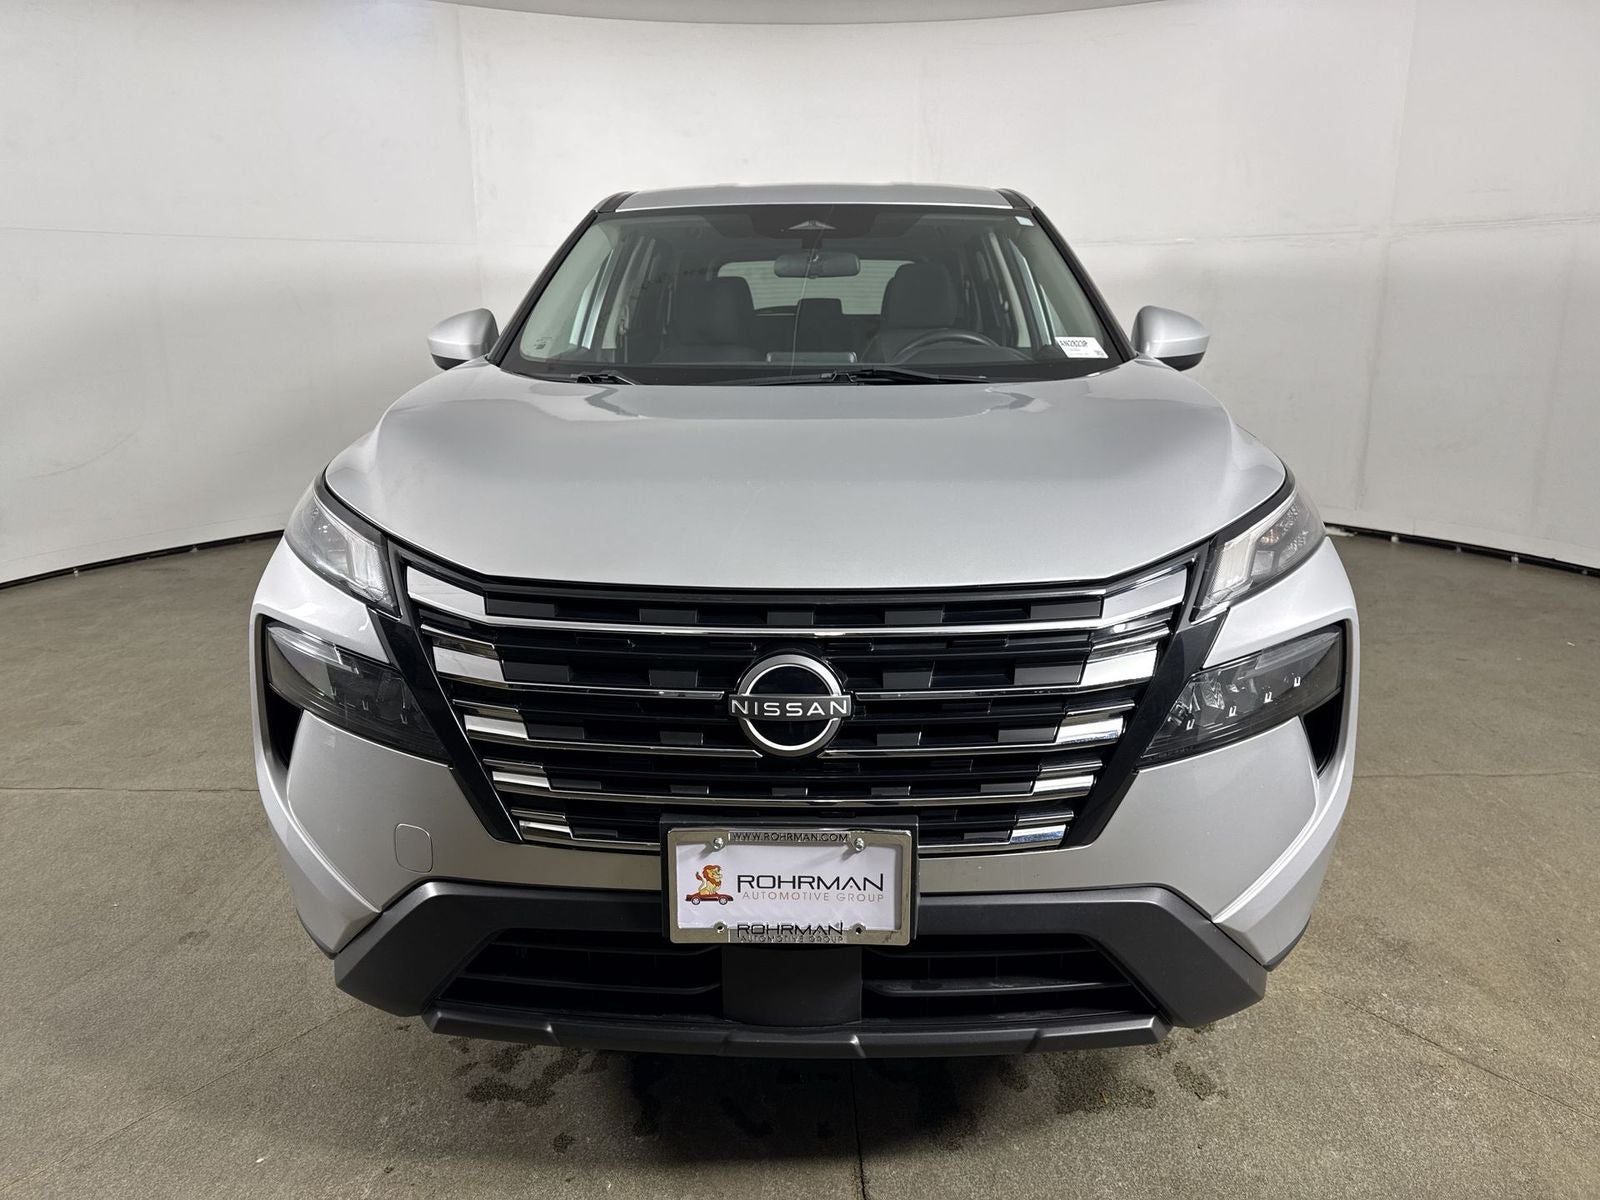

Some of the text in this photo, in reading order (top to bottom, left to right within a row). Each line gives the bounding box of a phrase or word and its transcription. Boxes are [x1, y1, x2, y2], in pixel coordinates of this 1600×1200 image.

[731, 699, 847, 716] NISSAN
[733, 832, 848, 843] WWW.ROHRMAN.COM
[737, 873, 884, 893] ROHRMAN
[743, 891, 885, 903] AUTOMOTIVE GROUP
[737, 920, 844, 937] ROHRMAN
[740, 935, 844, 943] AUTOMOTIVE GROUP
